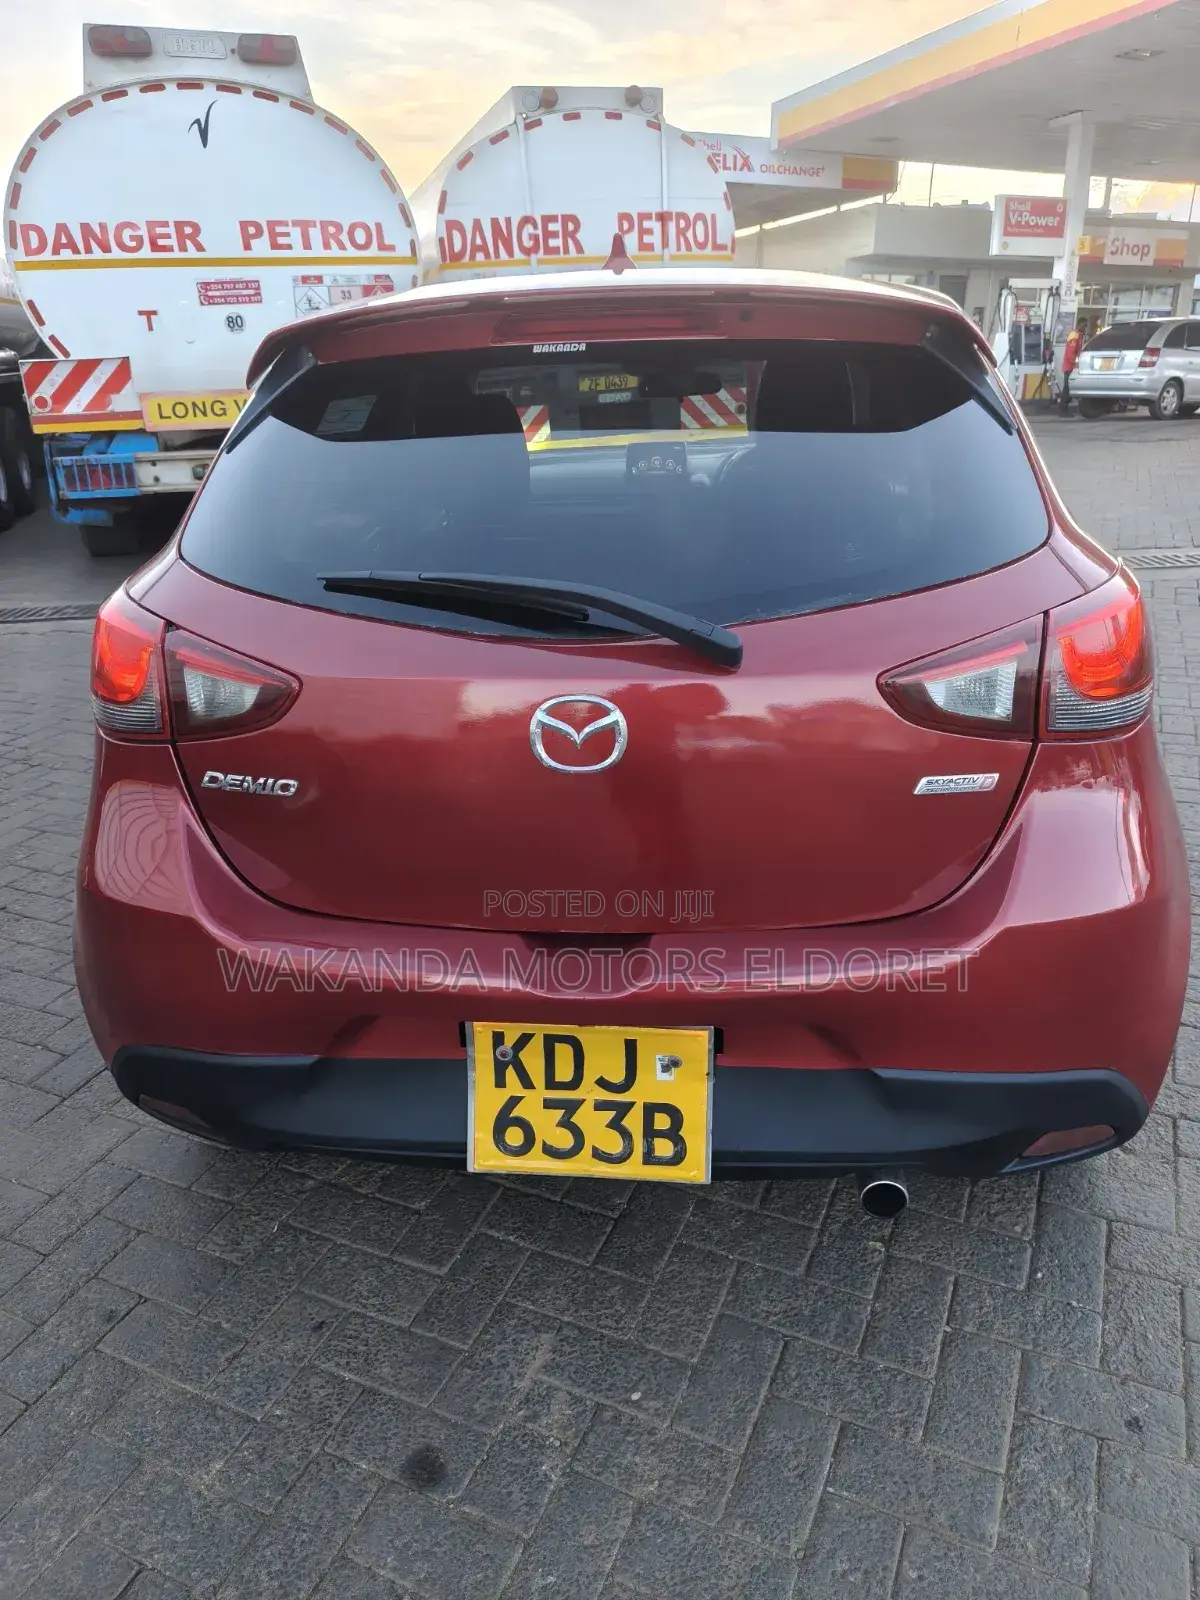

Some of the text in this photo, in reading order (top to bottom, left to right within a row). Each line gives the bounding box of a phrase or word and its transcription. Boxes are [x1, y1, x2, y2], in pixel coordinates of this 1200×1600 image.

[20, 219, 396, 257] DANGER PETROL
[445, 211, 728, 263] DANGER PETROL
[1109, 237, 1150, 261] Shop
[341, 290, 352, 300] 33
[138, 310, 158, 331] T
[227, 315, 244, 328] 80
[533, 343, 586, 353] WAKANDA
[157, 400, 227, 419] LONG
[201, 770, 298, 796] DEMIO
[925, 776, 980, 786] SKYACTIV
[491, 1030, 638, 1094] KDJ
[492, 1095, 688, 1166] 633B
